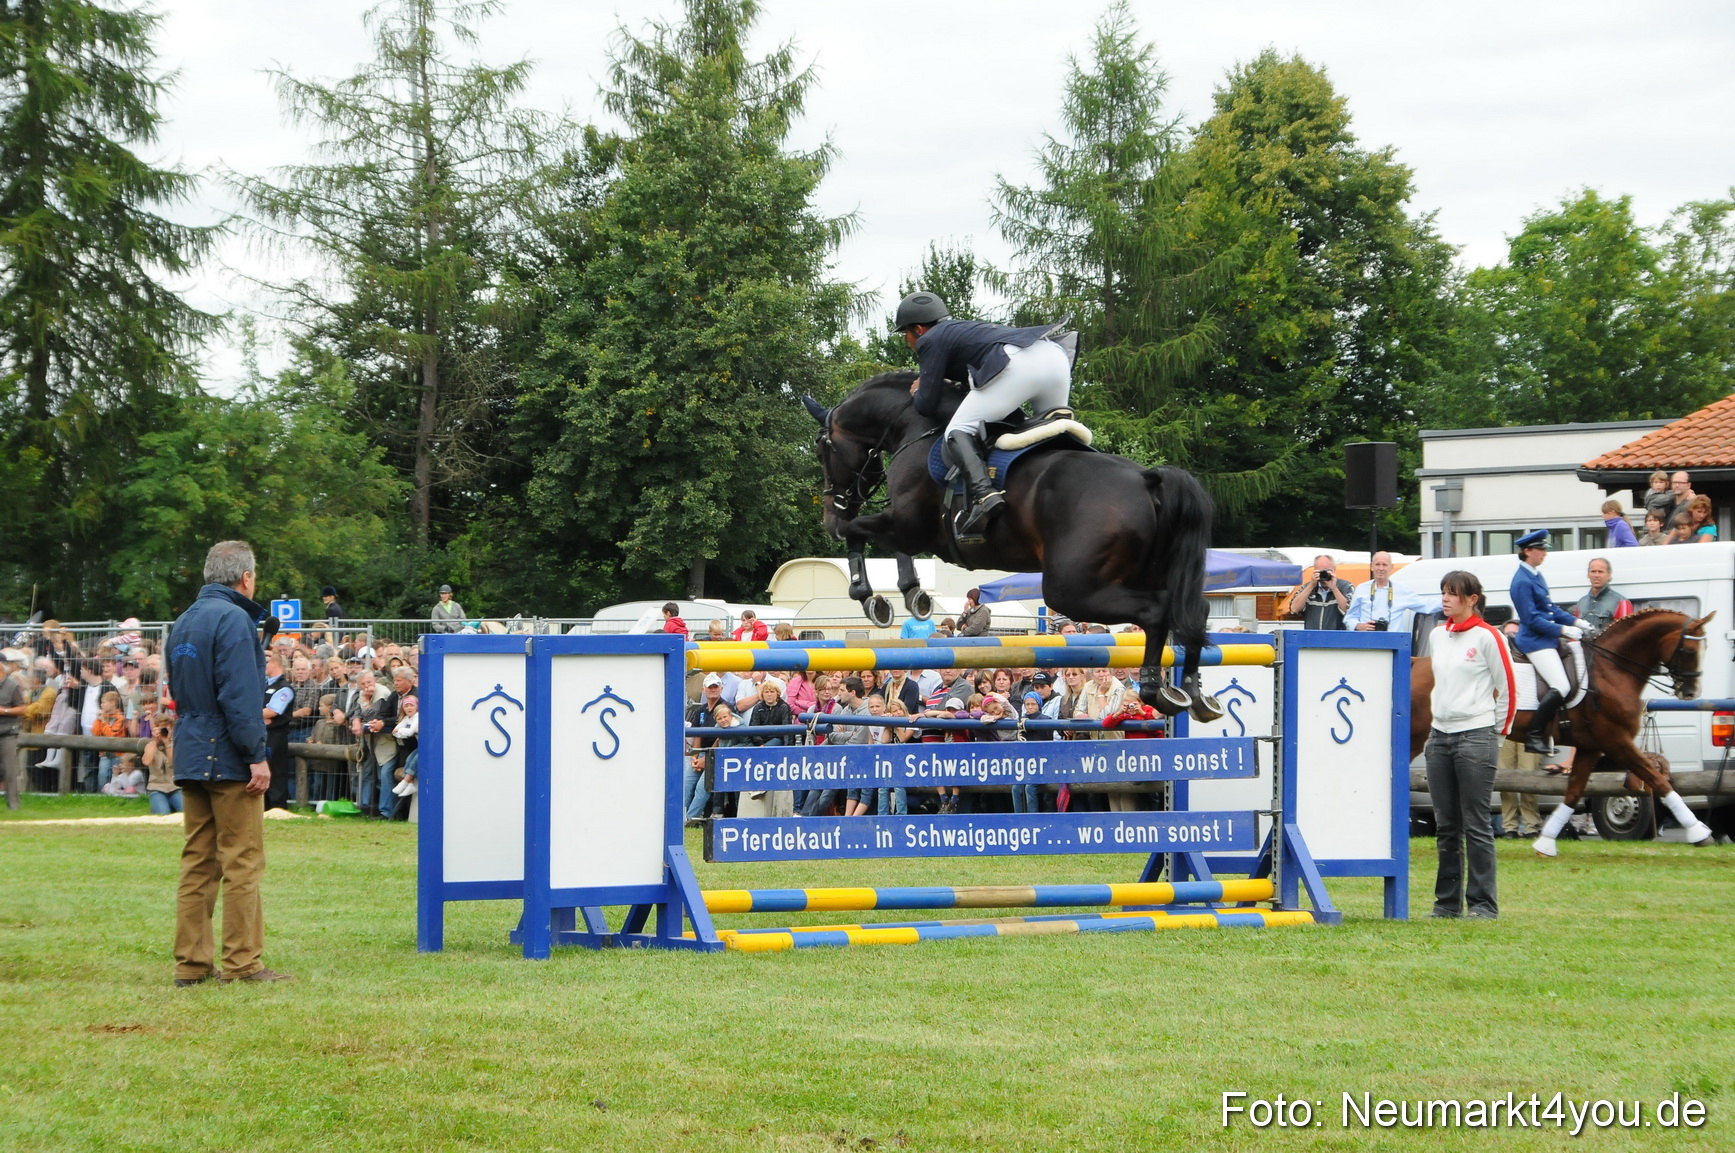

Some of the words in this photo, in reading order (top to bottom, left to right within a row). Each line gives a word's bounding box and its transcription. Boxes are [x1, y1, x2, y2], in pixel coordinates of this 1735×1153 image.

[278, 603, 295, 629] P
[484, 706, 512, 758] S
[592, 707, 620, 760] S
[1330, 696, 1354, 745] S
[874, 754, 893, 779] in
[1080, 756, 1108, 774] wo
[1115, 749, 1163, 774] denn
[875, 824, 893, 849] in
[1077, 826, 1104, 844] wo
[1113, 820, 1160, 844] denn
